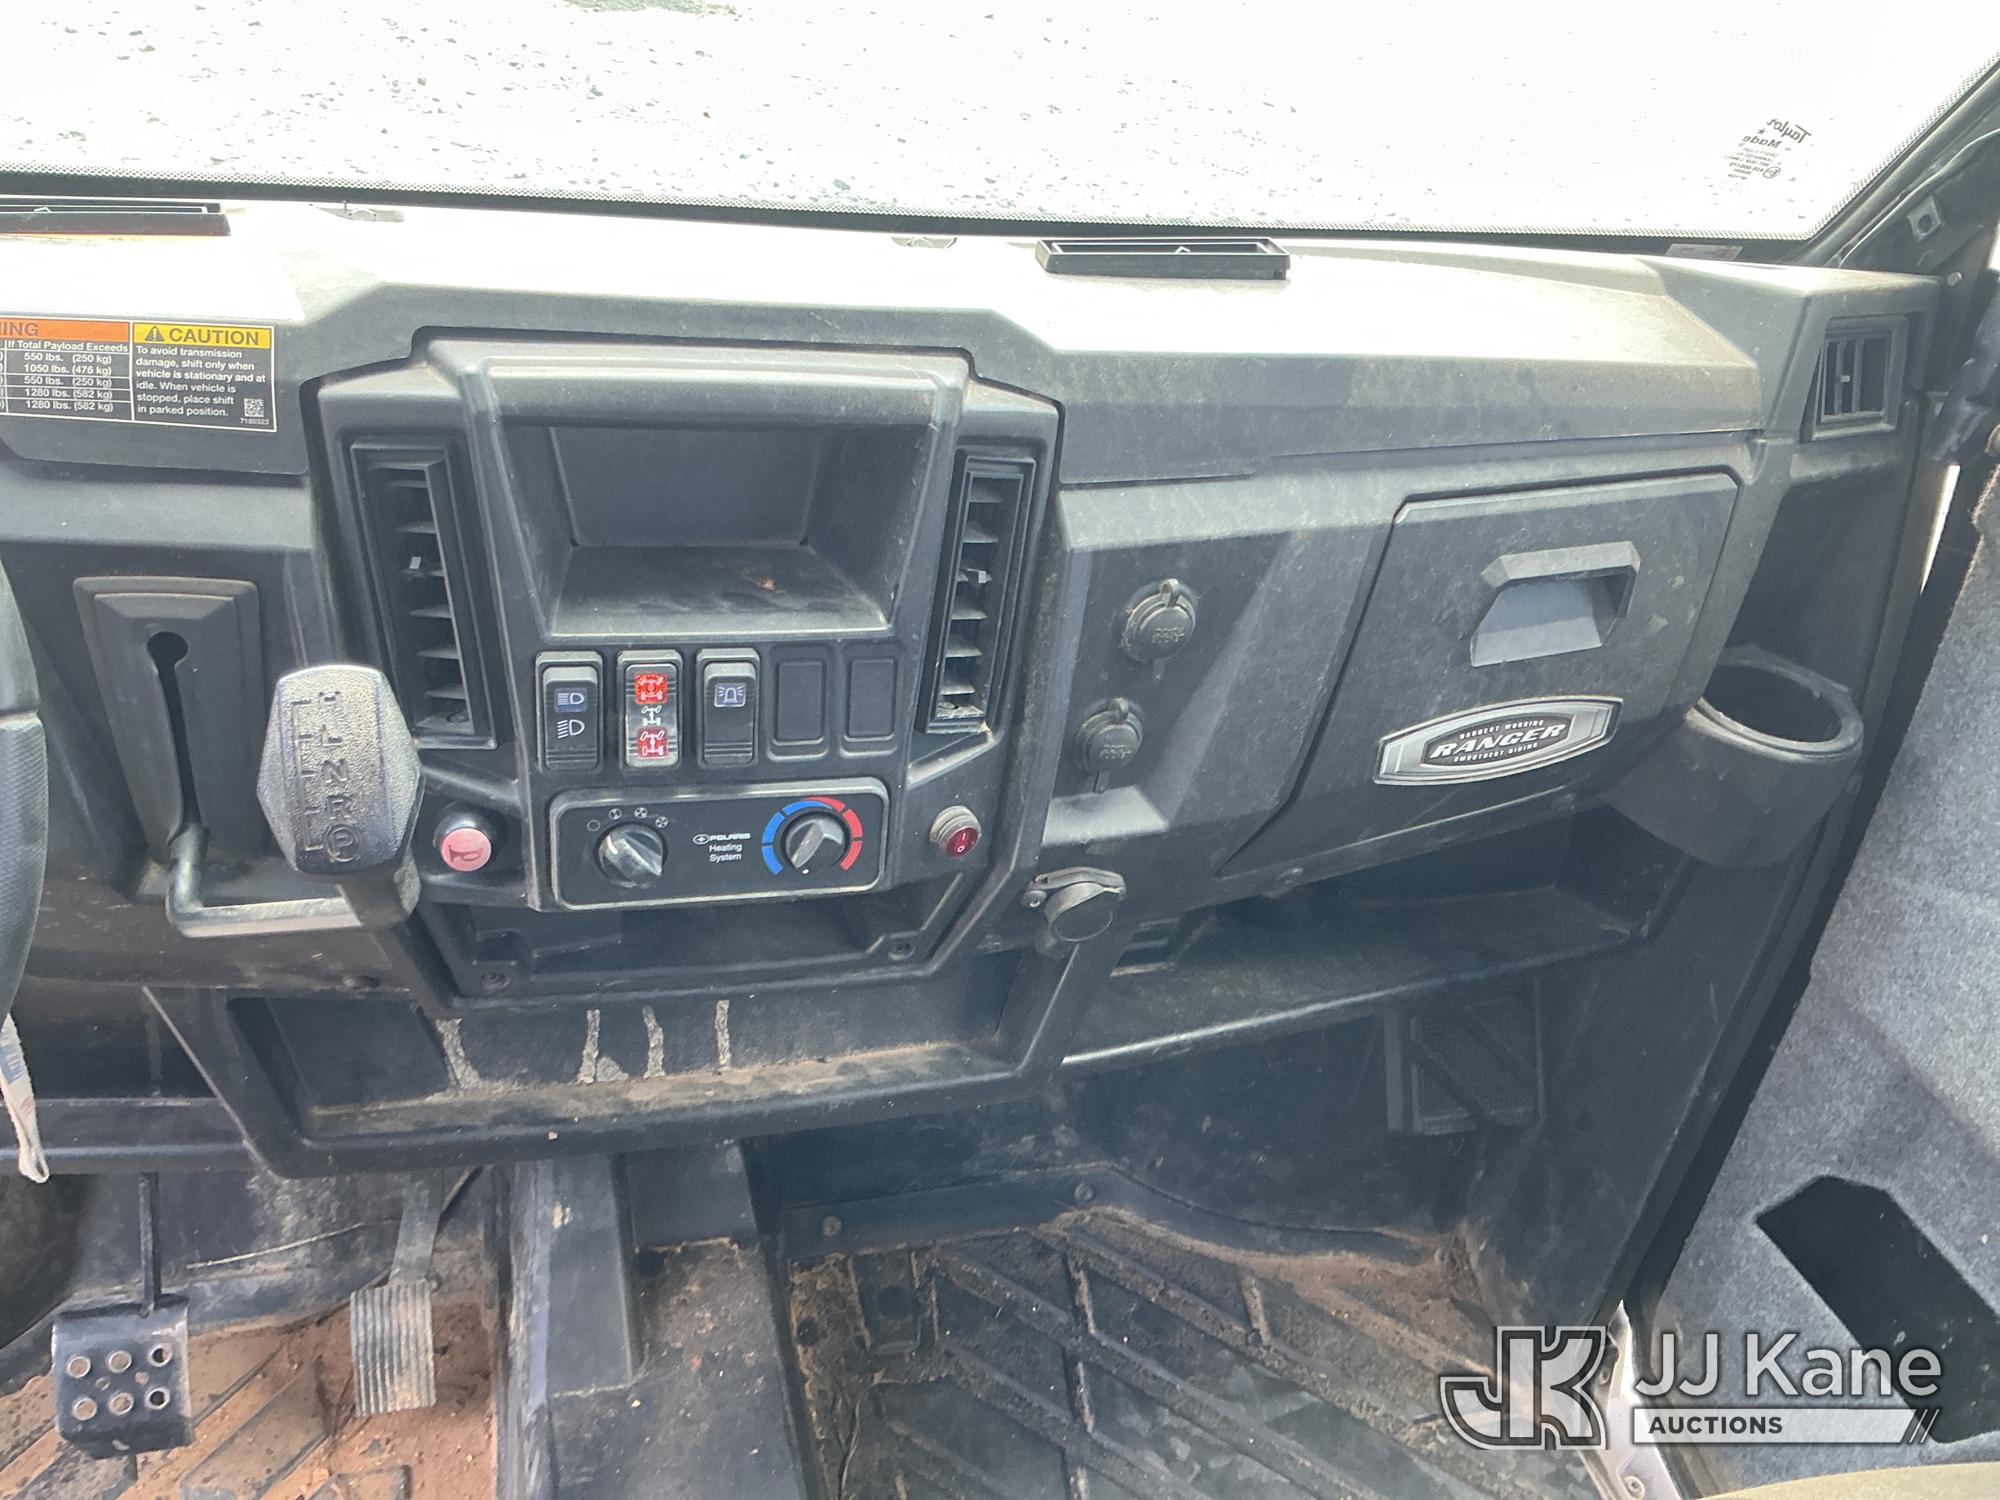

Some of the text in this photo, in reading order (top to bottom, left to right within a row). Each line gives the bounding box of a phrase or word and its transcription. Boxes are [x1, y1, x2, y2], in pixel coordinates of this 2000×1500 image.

[0, 321, 39, 337] ING
[169, 327, 260, 346] CAUTION
[8, 339, 128, 353] If Total Payload Exceeds
[135, 345, 242, 359] To avoid transmission
[24, 352, 112, 365] 550 lbs. (250 kg)
[181, 359, 203, 368] shift
[205, 360, 226, 371] only
[228, 361, 255, 371] when
[24, 363, 112, 377] 1050 lbs. (476 kg)
[135, 369, 266, 383] vehicle is stationary and at
[24, 375, 112, 389] 550 lbs. (250 kg)
[135, 380, 237, 394] idle. When vehicle is
[183, 394, 211, 405] place
[212, 396, 235, 405] shift
[137, 404, 229, 417] in parked position.
[1504, 719, 1545, 730] WORKING
[1429, 724, 1567, 759] RANGER
[710, 832, 751, 841] POLARIS
[709, 843, 743, 852] Heating
[709, 853, 743, 863] System
